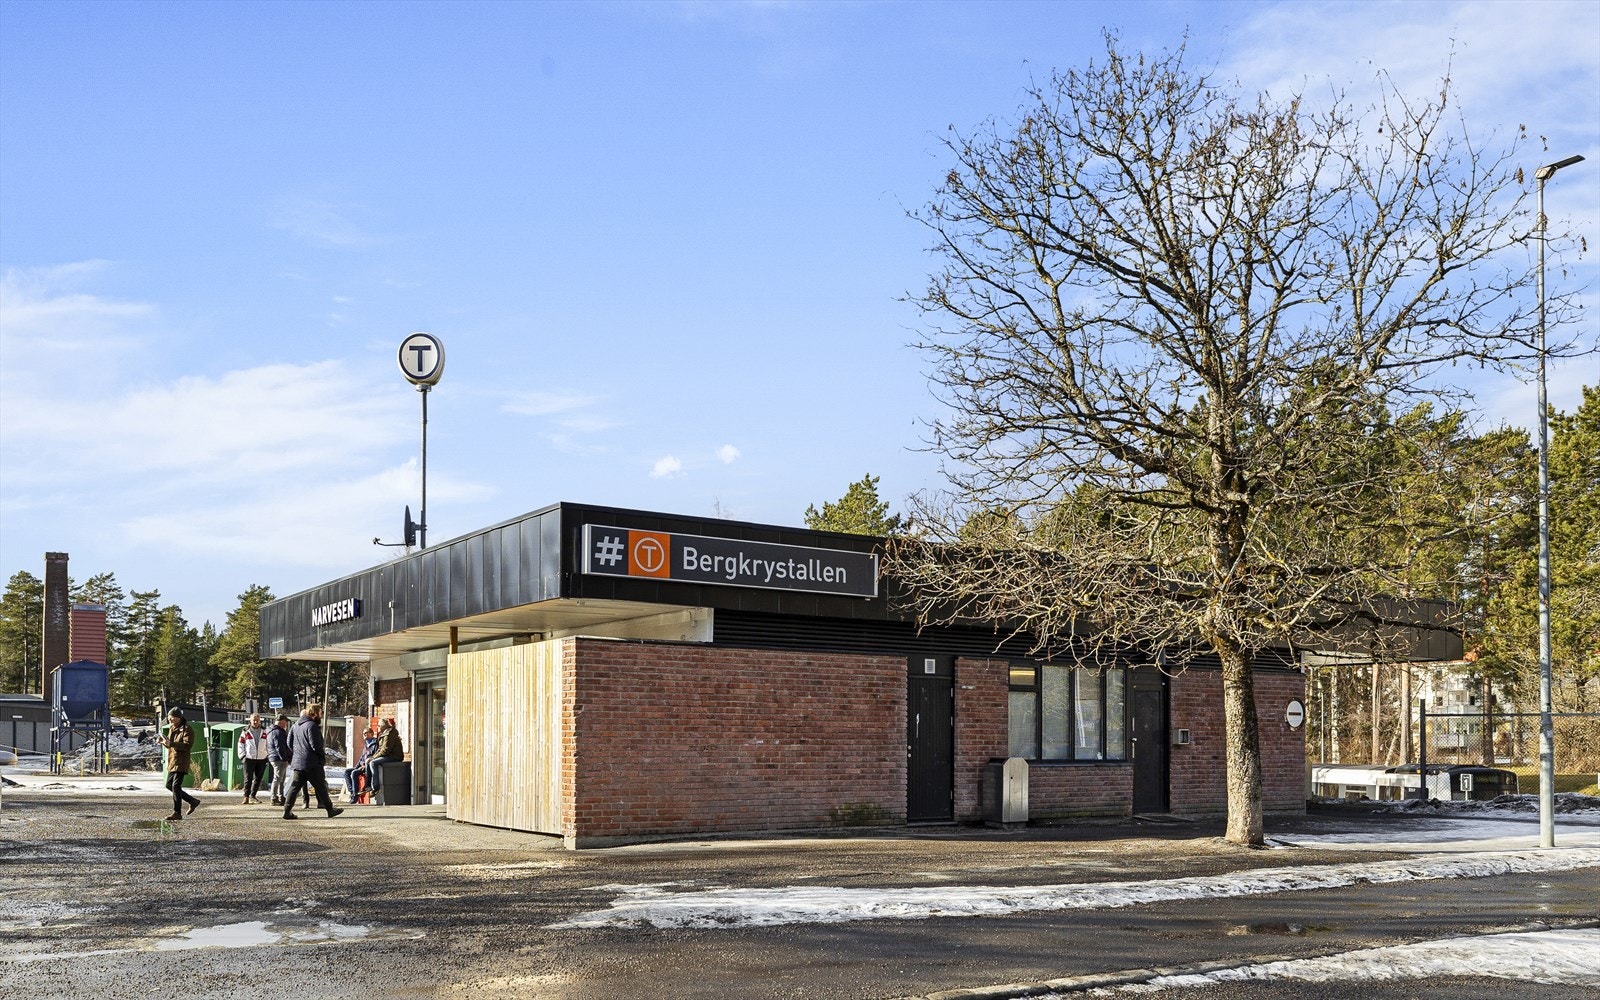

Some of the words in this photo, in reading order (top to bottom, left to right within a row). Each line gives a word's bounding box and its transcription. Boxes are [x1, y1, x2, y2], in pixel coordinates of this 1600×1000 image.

[409, 345, 431, 372] T
[641, 545, 657, 568] T
[683, 546, 847, 584] Bergkrystallen
[312, 598, 354, 627] NARVESEN
